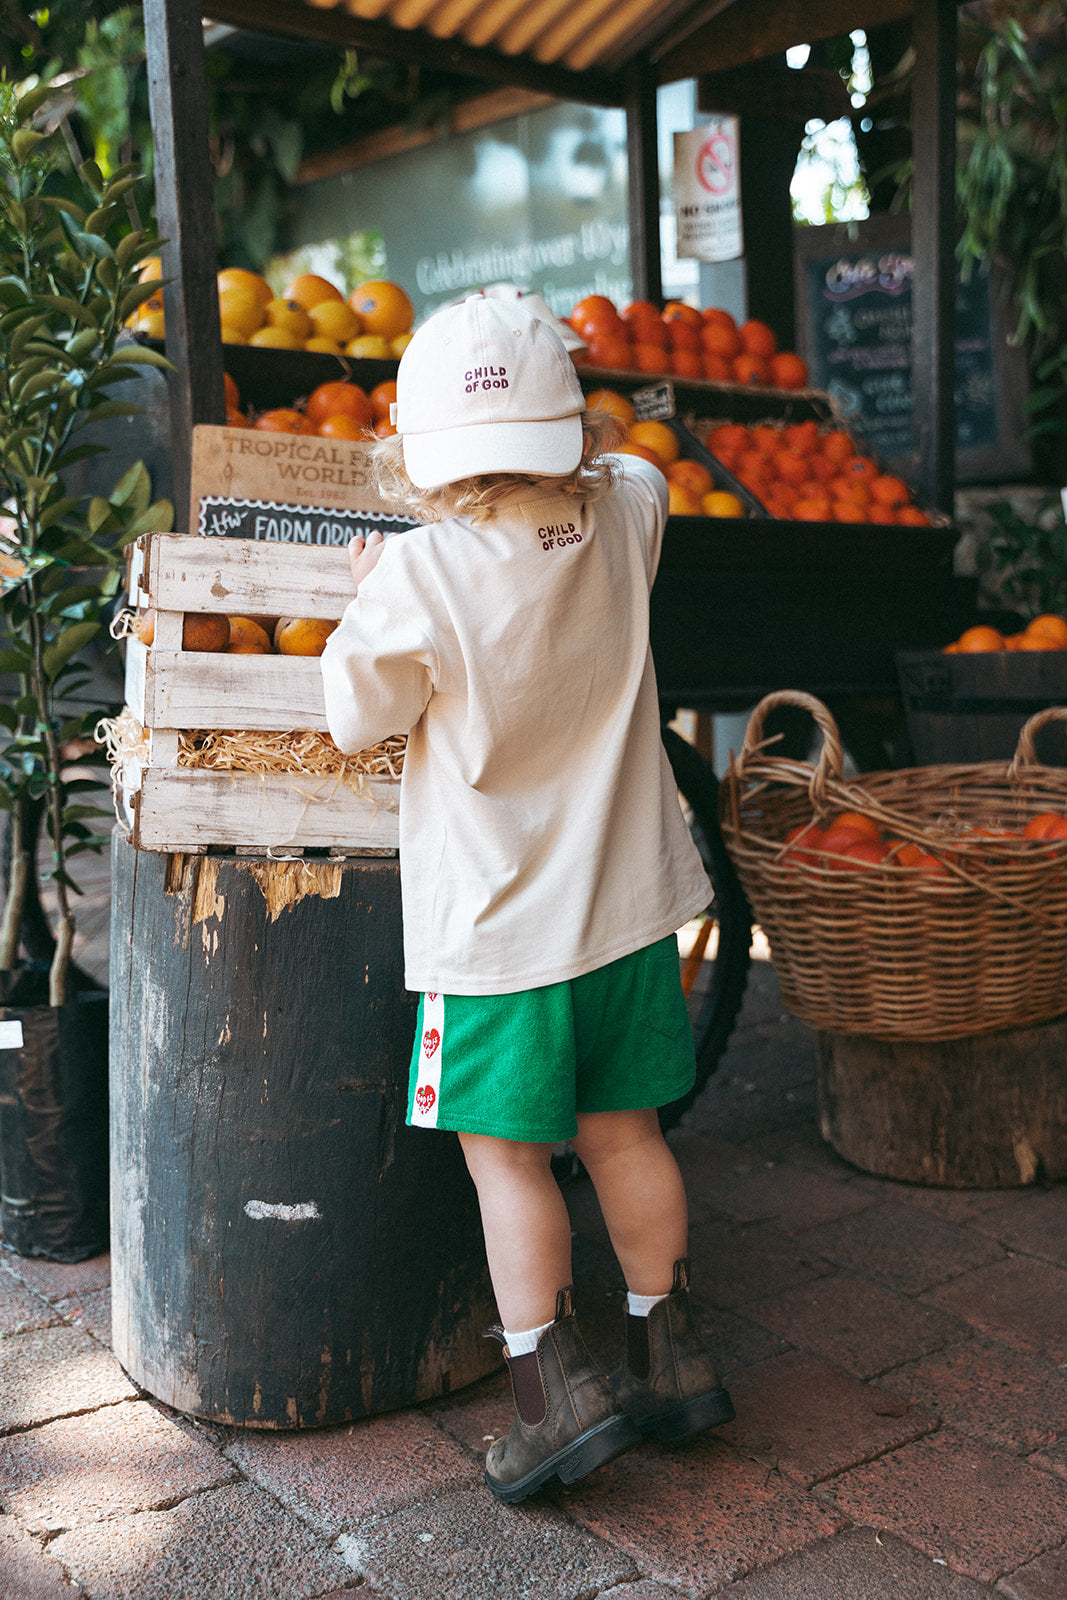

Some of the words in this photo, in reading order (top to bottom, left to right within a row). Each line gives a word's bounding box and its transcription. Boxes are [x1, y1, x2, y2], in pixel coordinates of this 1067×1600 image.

[464, 366, 507, 381] CHILD
[465, 381, 479, 393] OF
[482, 378, 509, 391] GOD
[277, 461, 368, 486] WORLD
[255, 515, 312, 543] FARM
[538, 523, 575, 539] CHILD
[542, 538, 555, 551] OF
[557, 533, 583, 547] GOD
